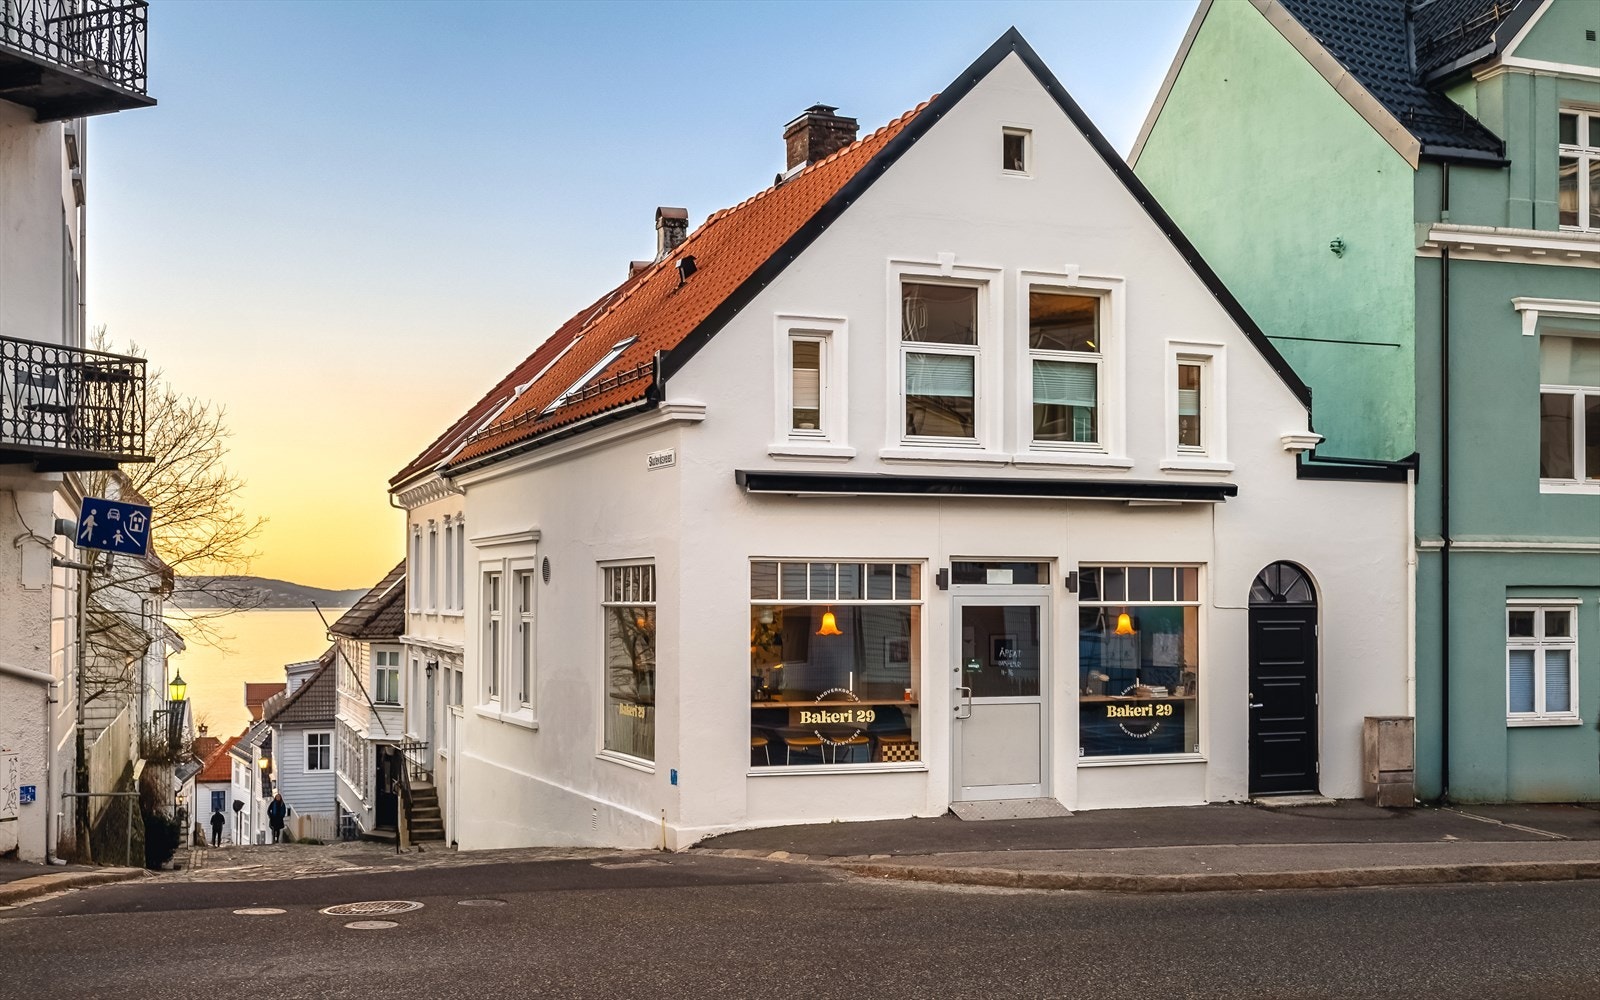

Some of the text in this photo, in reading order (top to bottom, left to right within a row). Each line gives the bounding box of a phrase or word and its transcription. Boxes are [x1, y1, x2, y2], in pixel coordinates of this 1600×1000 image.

[619, 703, 637, 717] Bakeri
[800, 710, 876, 724] Bakeri 29
[1106, 704, 1173, 718] Bakeri 29
